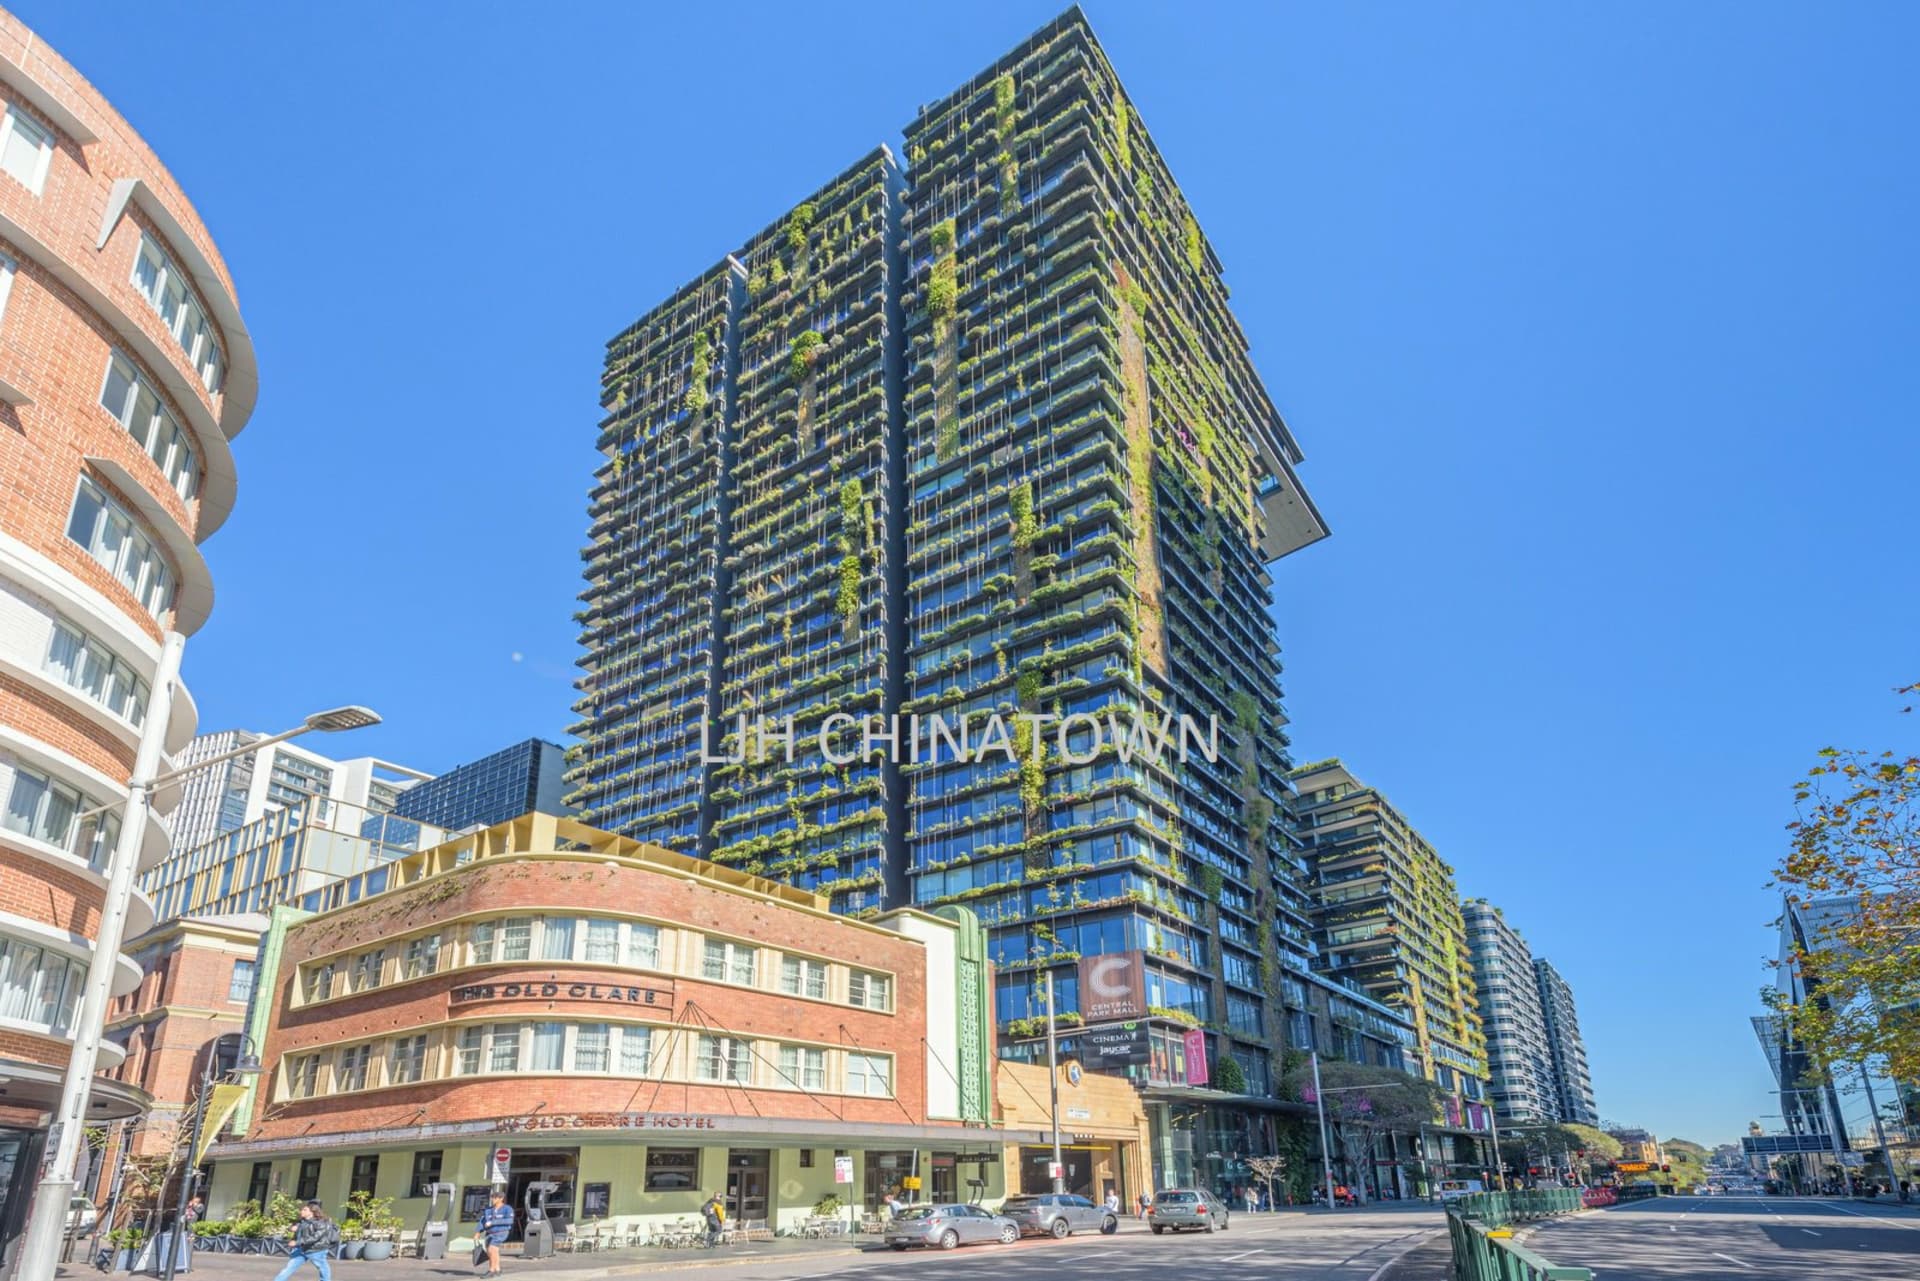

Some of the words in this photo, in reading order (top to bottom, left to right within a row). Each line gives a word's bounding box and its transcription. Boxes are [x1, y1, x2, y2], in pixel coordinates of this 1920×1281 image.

[502, 983, 559, 998] OLD
[568, 983, 656, 1004] CLARE
[1087, 1010, 1111, 1018] PARK
[1112, 1006, 1139, 1015] MALL
[1091, 1001, 1134, 1011] CENTRAL
[1092, 1034, 1130, 1044] CINEMA
[524, 1115, 564, 1131] OLD
[572, 1115, 645, 1128] CLARE
[652, 1115, 716, 1129] HOTEL
